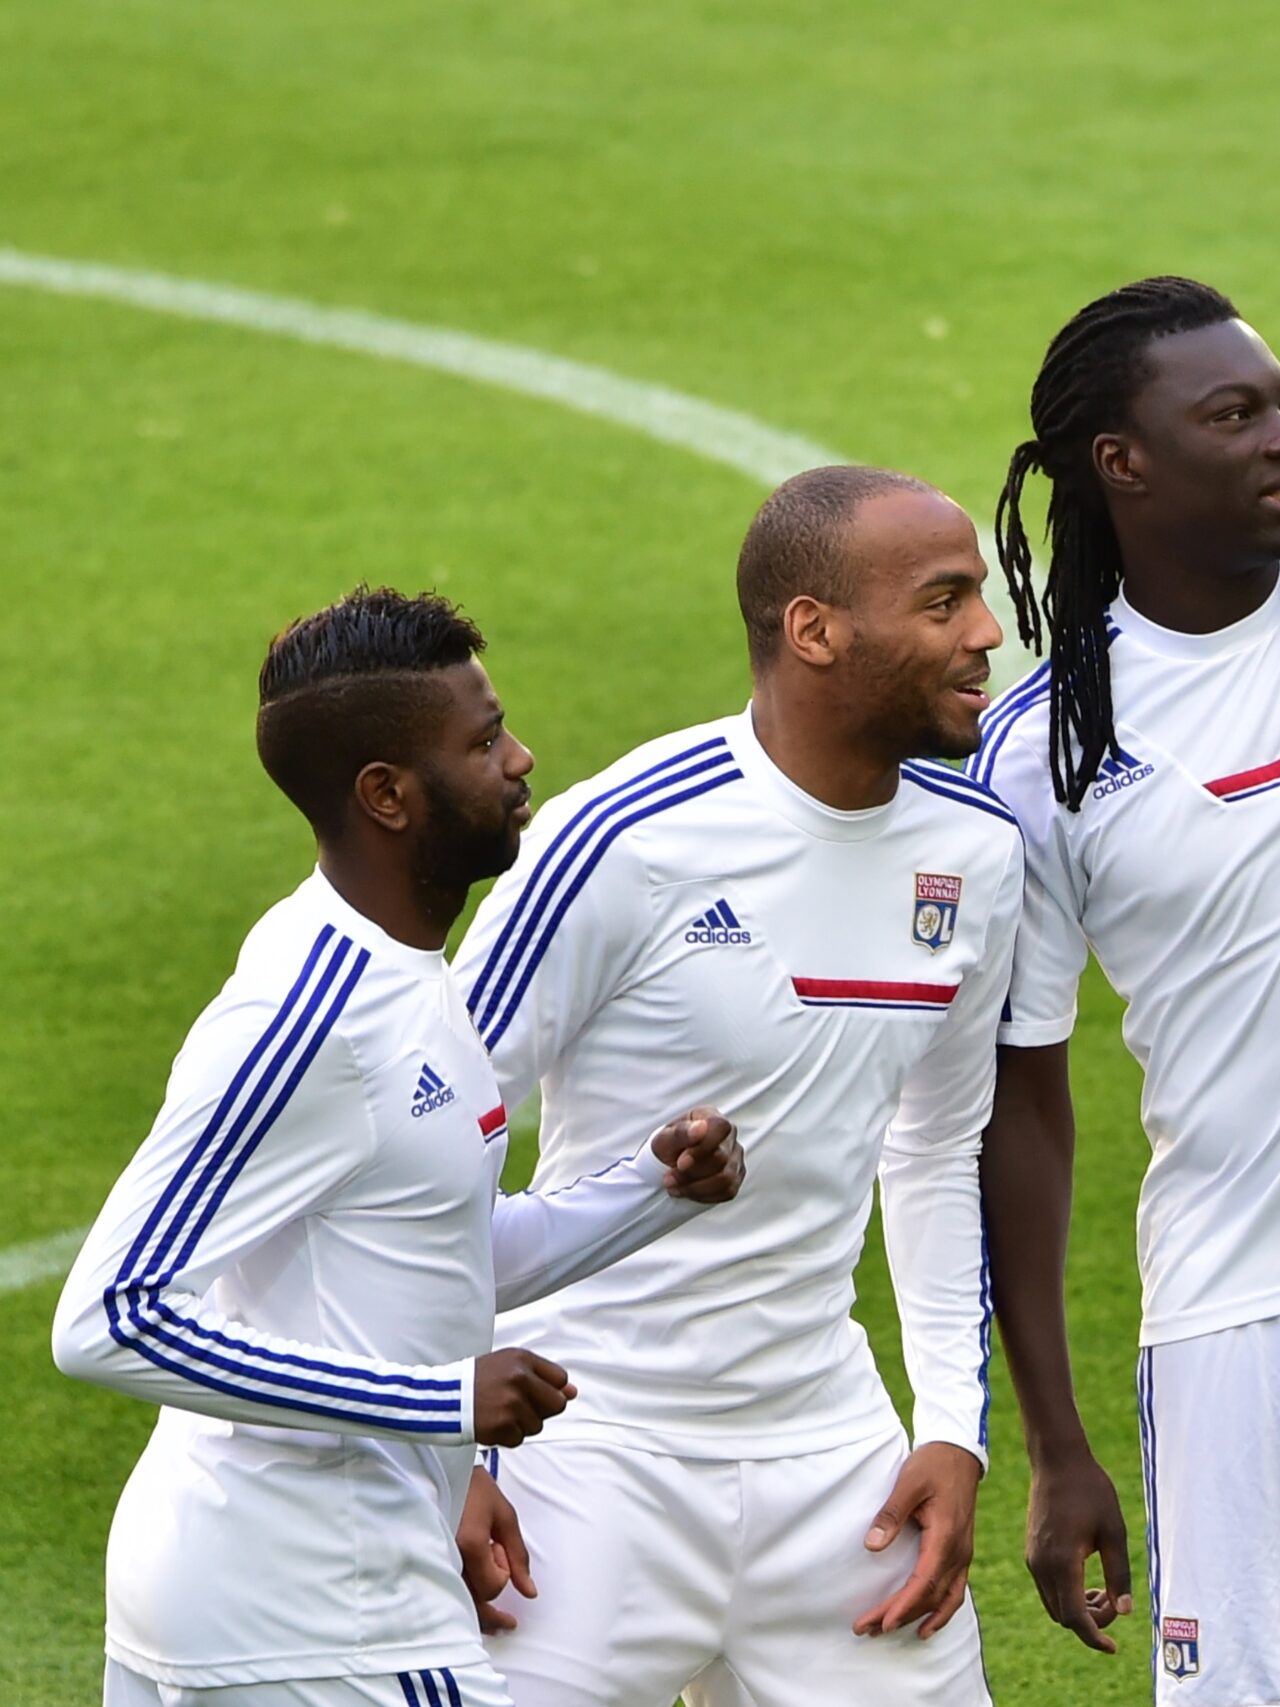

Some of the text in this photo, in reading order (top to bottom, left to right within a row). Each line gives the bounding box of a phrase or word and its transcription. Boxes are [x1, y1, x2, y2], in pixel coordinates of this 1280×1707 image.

[1093, 763, 1155, 800] adidas
[917, 886, 960, 900] LYONNAIS
[684, 927, 752, 944] adidas
[411, 1086, 455, 1118] adidas
